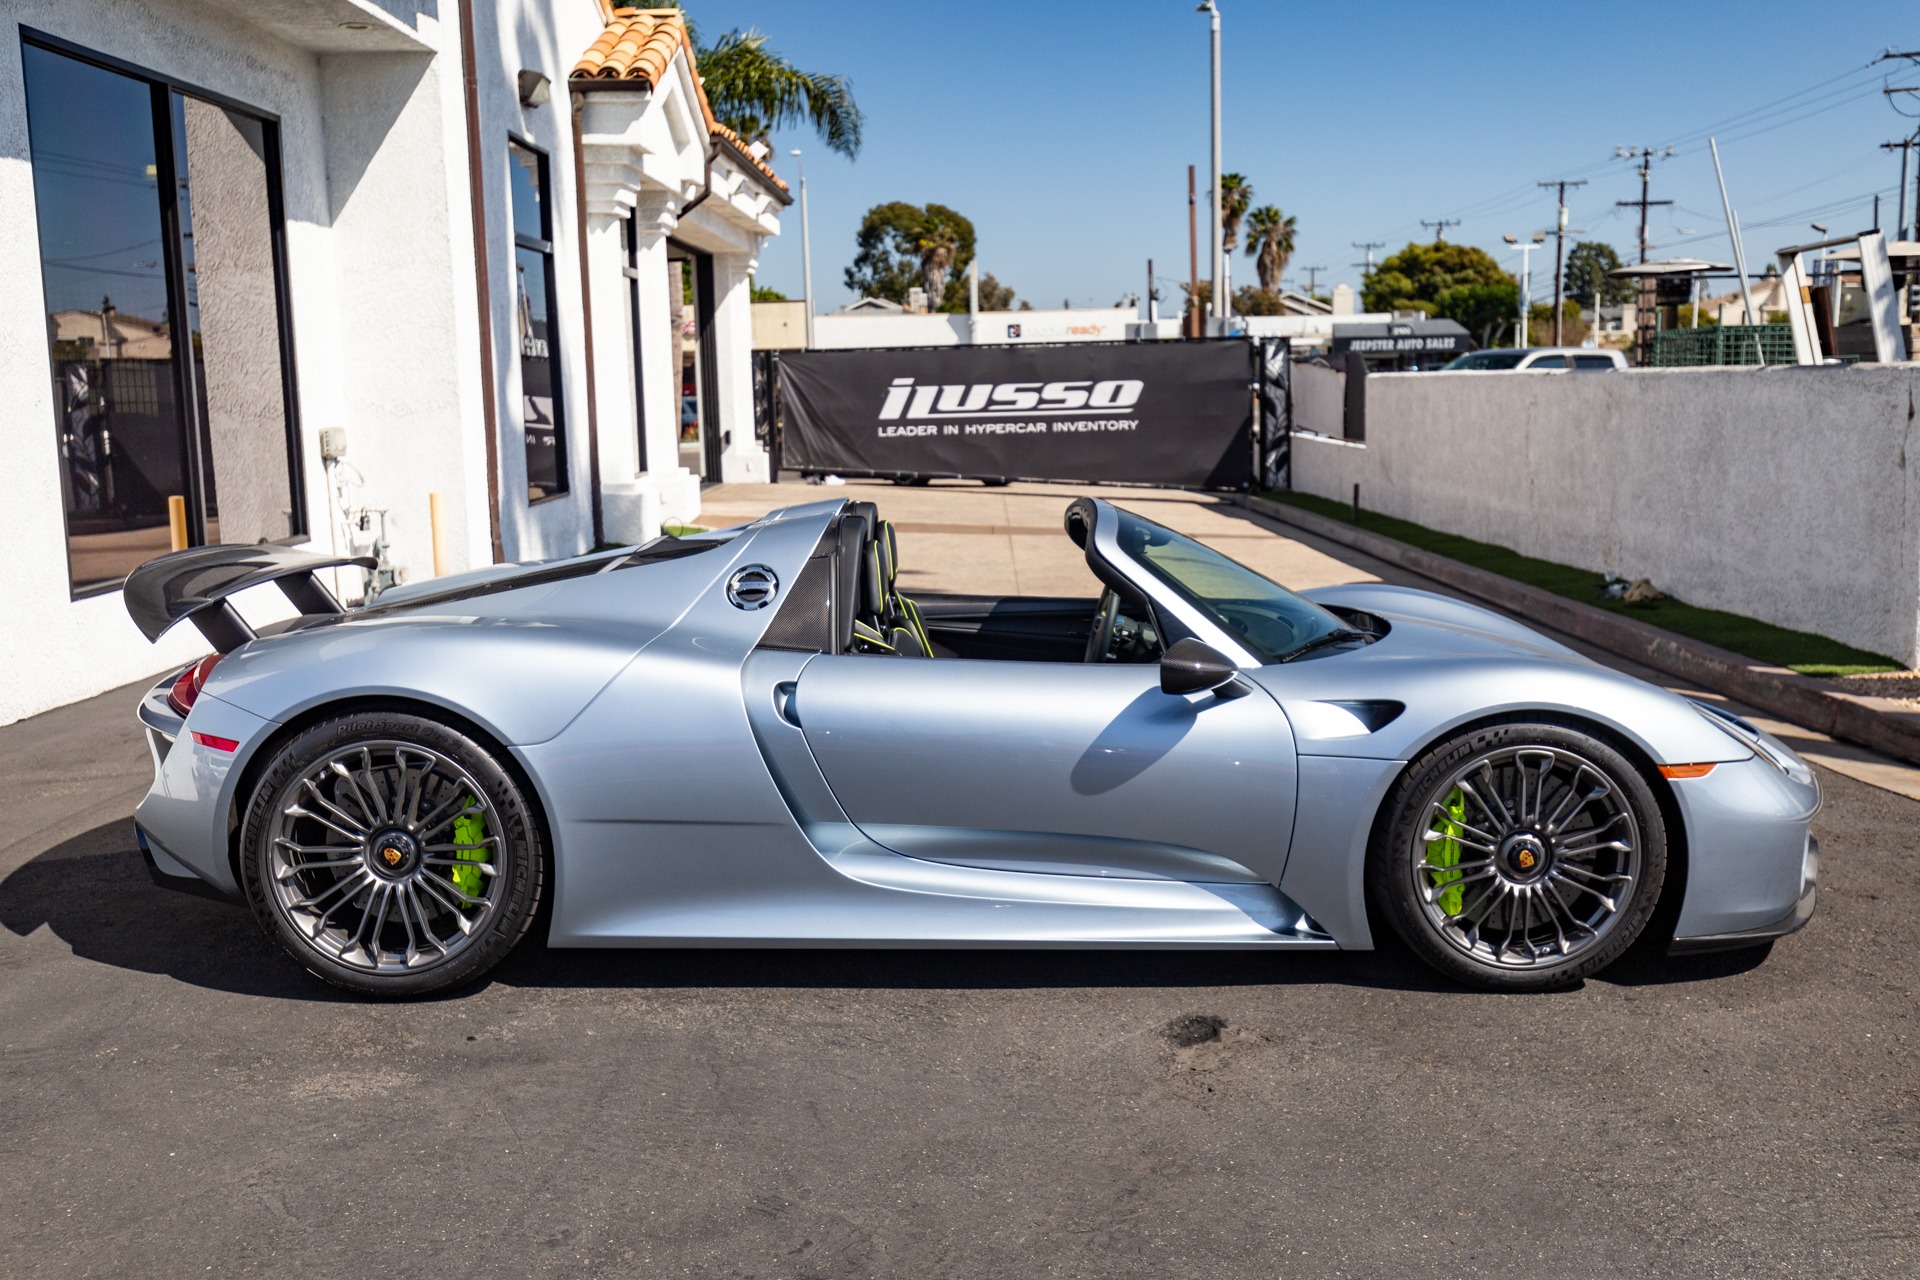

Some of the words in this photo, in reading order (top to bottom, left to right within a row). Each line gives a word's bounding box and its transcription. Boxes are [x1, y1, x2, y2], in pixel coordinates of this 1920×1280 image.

[1350, 339, 1394, 351] JEEPSTER
[1396, 338, 1424, 349] AUTO
[1425, 337, 1455, 349] SALES
[878, 425, 938, 437] LEADER
[943, 424, 959, 435] IN
[964, 422, 1047, 435] HYPERCAR
[1052, 419, 1139, 432] INVENTORY
[337, 720, 375, 736] Pilot
[375, 719, 420, 734] Sport
[421, 726, 449, 744] Cup
[1410, 743, 1471, 806] MICHELIN
[245, 780, 274, 879] MICHELIN
[500, 838, 528, 932] MICHELIN
[1582, 910, 1643, 972] MICHELIN
